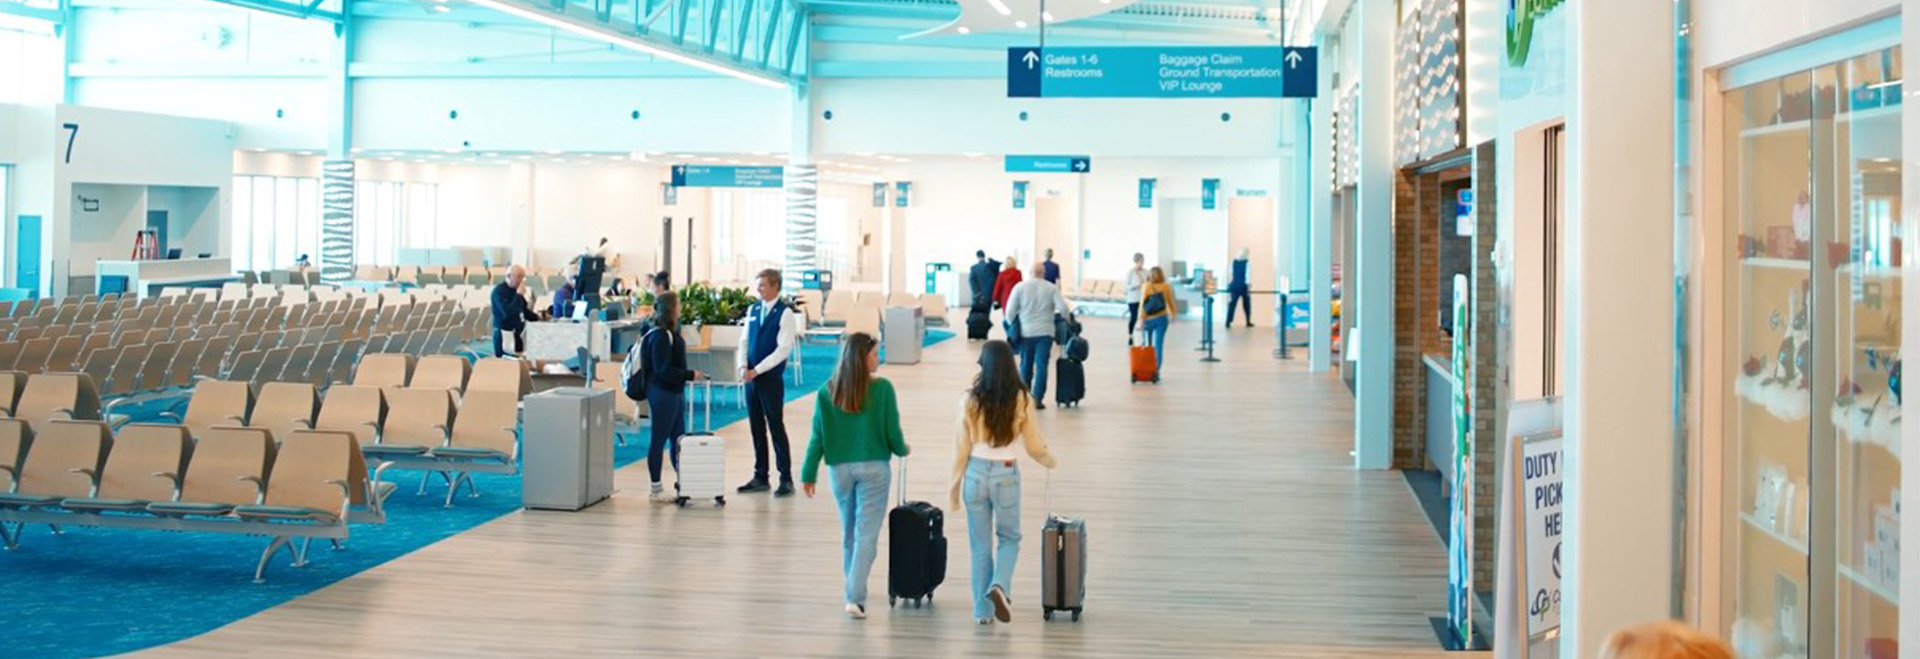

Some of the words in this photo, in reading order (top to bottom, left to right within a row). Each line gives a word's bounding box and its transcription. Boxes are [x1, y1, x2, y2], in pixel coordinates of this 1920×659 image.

[1045, 54, 1077, 65] Gates
[1081, 54, 1098, 65] 1-6
[1159, 53, 1208, 66] Baggage
[1211, 53, 1243, 65] Claim
[1045, 67, 1103, 78] Restrooms
[1159, 67, 1199, 78] Ground
[1203, 66, 1281, 79] Transportation
[1159, 80, 1179, 91] VIP
[1182, 80, 1223, 93] Lounge
[63, 123, 78, 163] 7
[1525, 451, 1558, 480] DUTY
